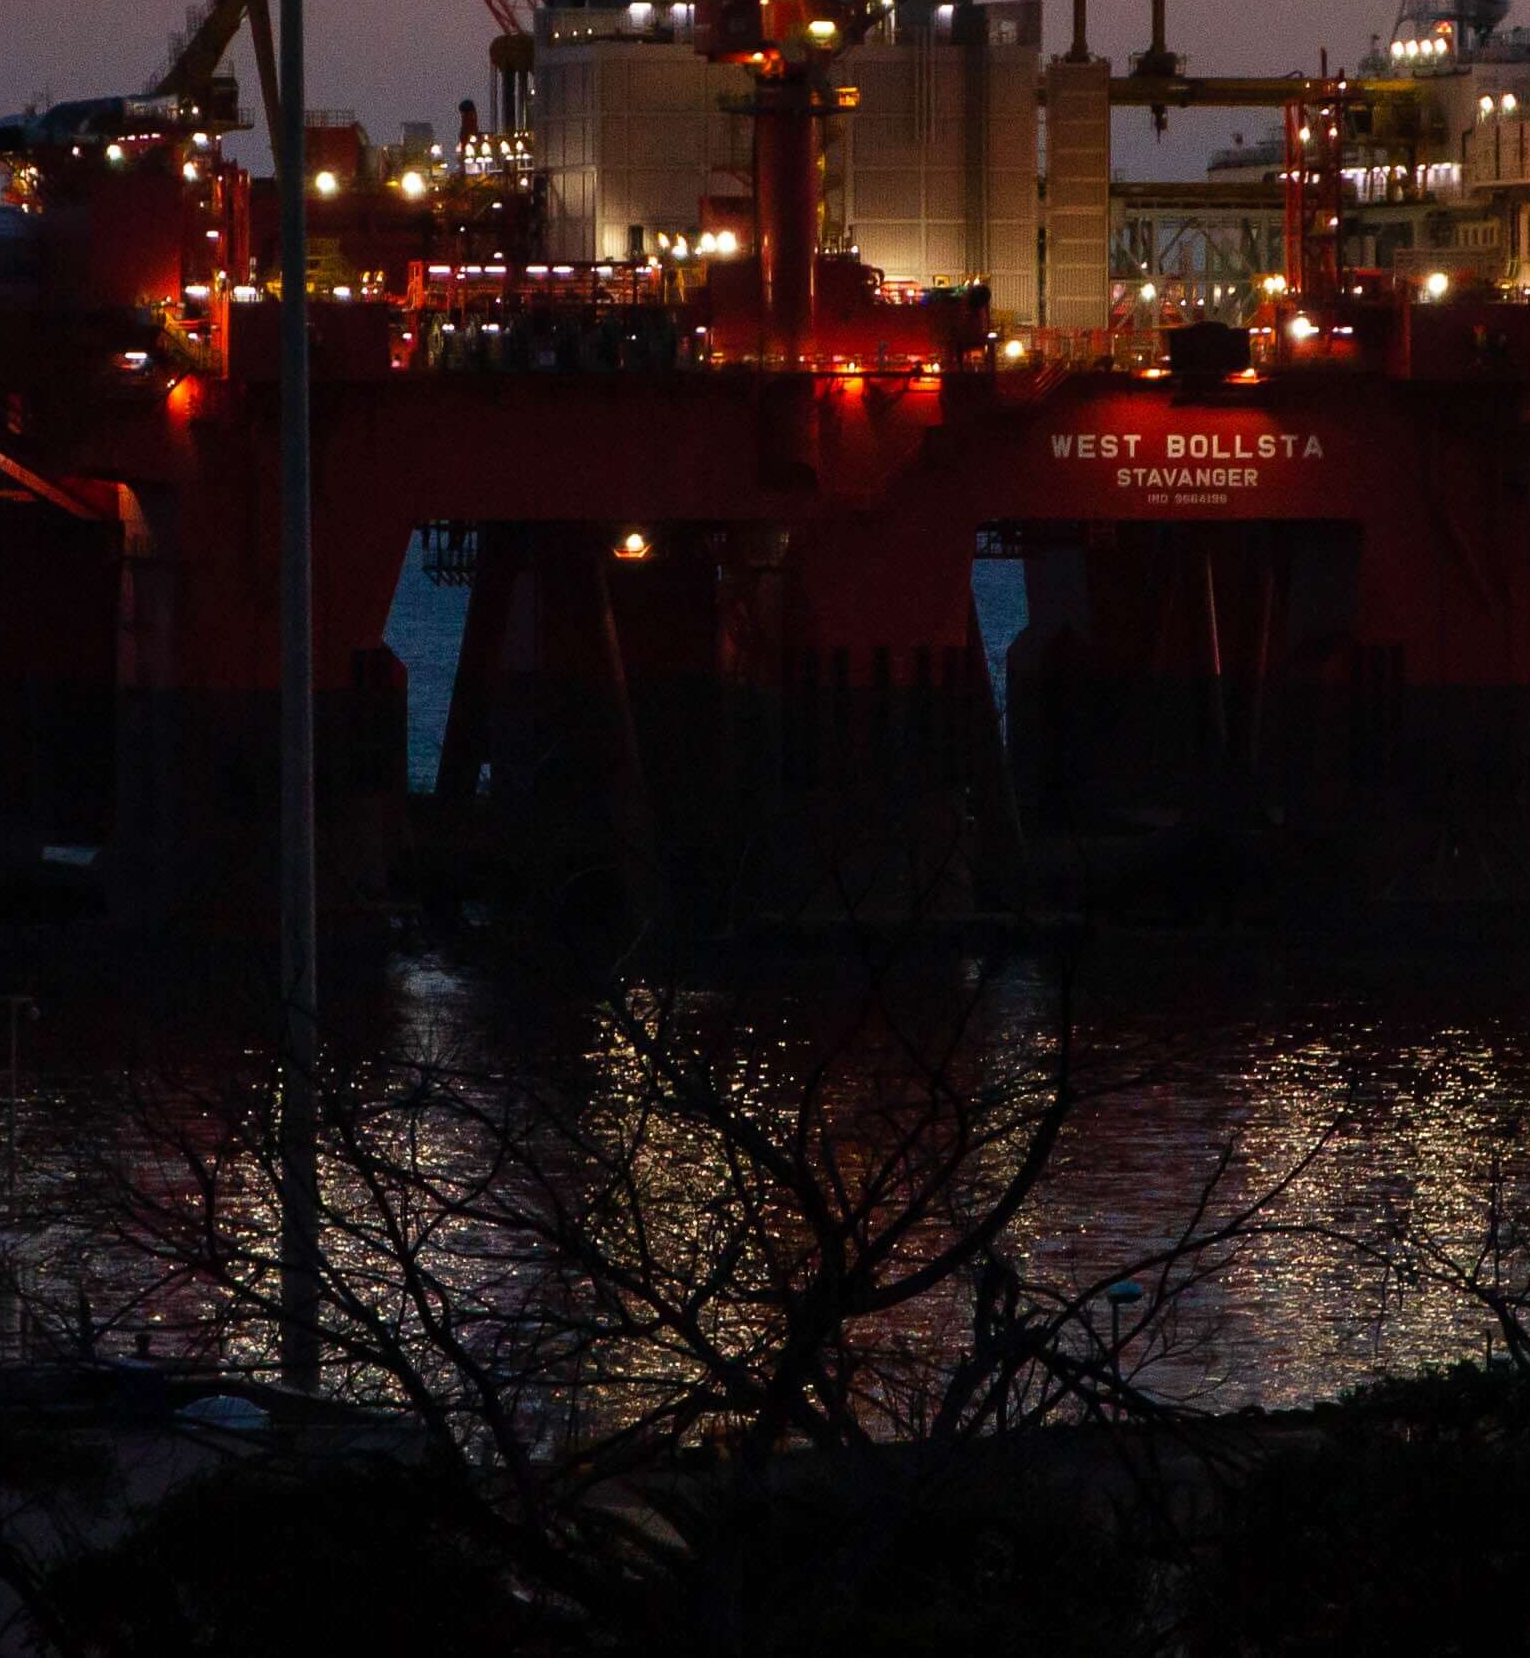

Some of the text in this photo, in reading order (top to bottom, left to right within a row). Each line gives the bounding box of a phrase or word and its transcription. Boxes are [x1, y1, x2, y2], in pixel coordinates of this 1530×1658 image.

[1050, 433, 1324, 459] WEST BOLLSTA
[1117, 467, 1259, 487] STAVANGER
